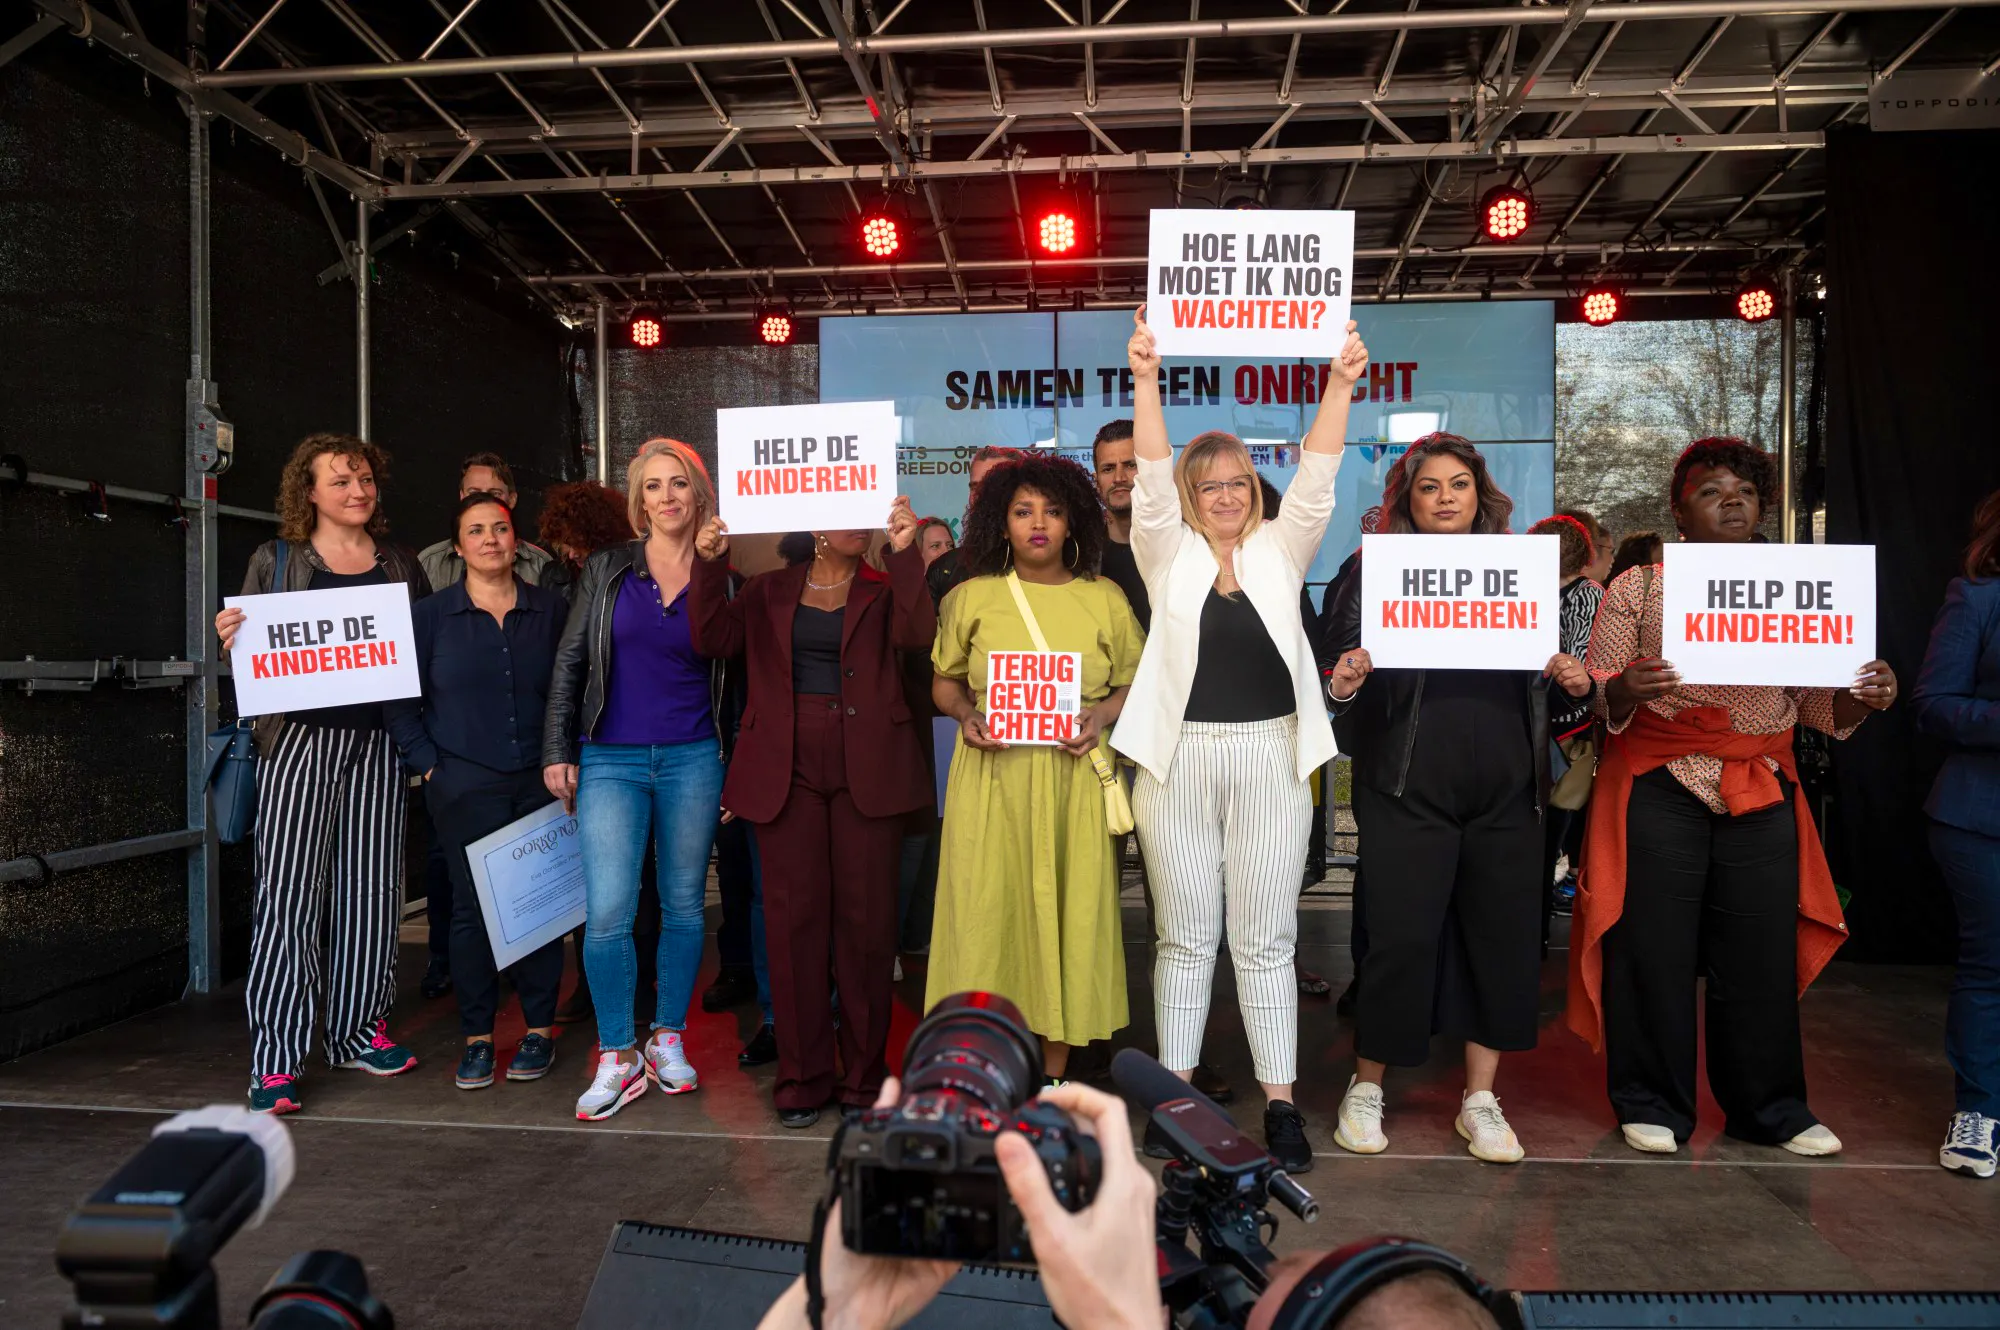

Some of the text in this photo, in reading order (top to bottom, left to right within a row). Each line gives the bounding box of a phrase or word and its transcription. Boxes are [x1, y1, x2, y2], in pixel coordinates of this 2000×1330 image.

[1182, 233, 1320, 263] HOE LANG
[1158, 266, 1342, 296] MOET IK NOG
[1172, 300, 1327, 329] WACHTEN?
[945, 368, 1084, 411] SAMEN
[754, 435, 859, 465] HELP DE
[896, 446, 928, 460] ITS
[737, 464, 877, 496] KINDEREN!
[1402, 569, 1518, 597] HELP DE
[1707, 580, 1833, 610] HELP DE
[1382, 600, 1538, 629] KINDEREN!
[1685, 613, 1853, 644] KINDEREN!
[267, 615, 377, 649] HELP DE
[251, 640, 398, 679] KINDEREN!
[990, 654, 1074, 682] TERUG
[989, 682, 1057, 711] GEVO
[988, 712, 1073, 741] CHTEN
[512, 818, 579, 860] OORKOND
